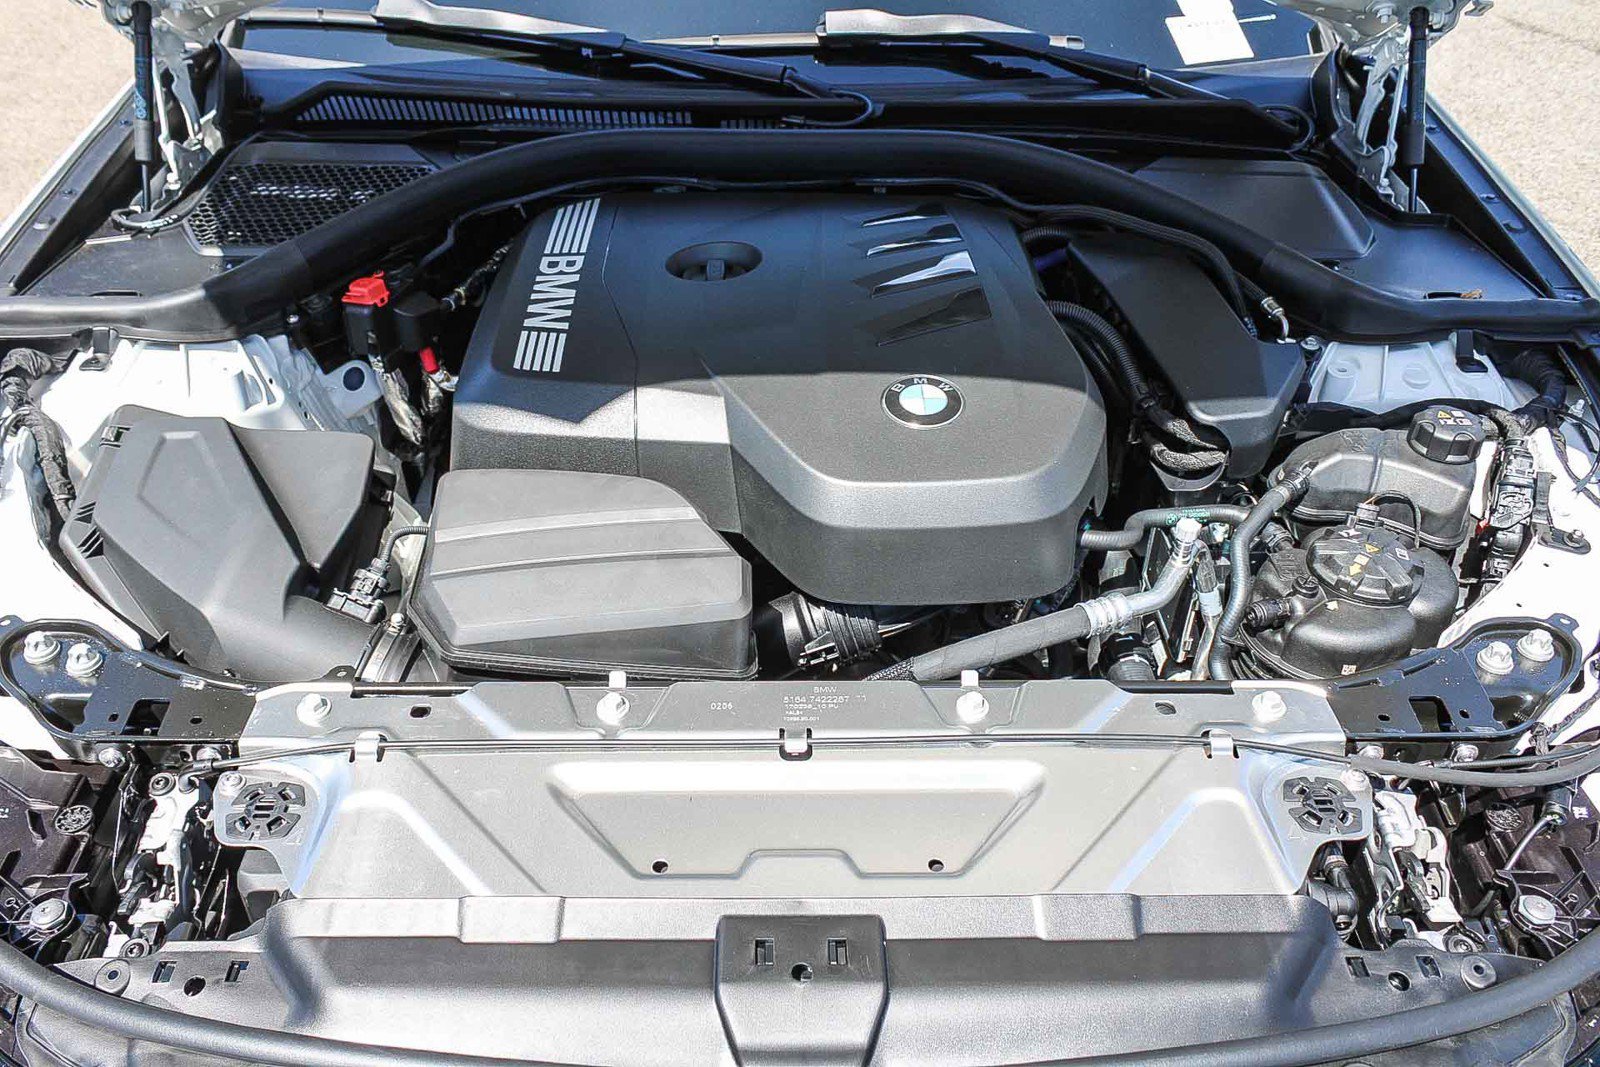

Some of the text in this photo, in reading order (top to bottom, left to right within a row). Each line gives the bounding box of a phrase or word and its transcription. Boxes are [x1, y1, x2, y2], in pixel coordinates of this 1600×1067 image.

[523, 254, 585, 330] BMW
[891, 377, 954, 393] BMW
[813, 686, 837, 694] BMW
[710, 702, 733, 710] 0206
